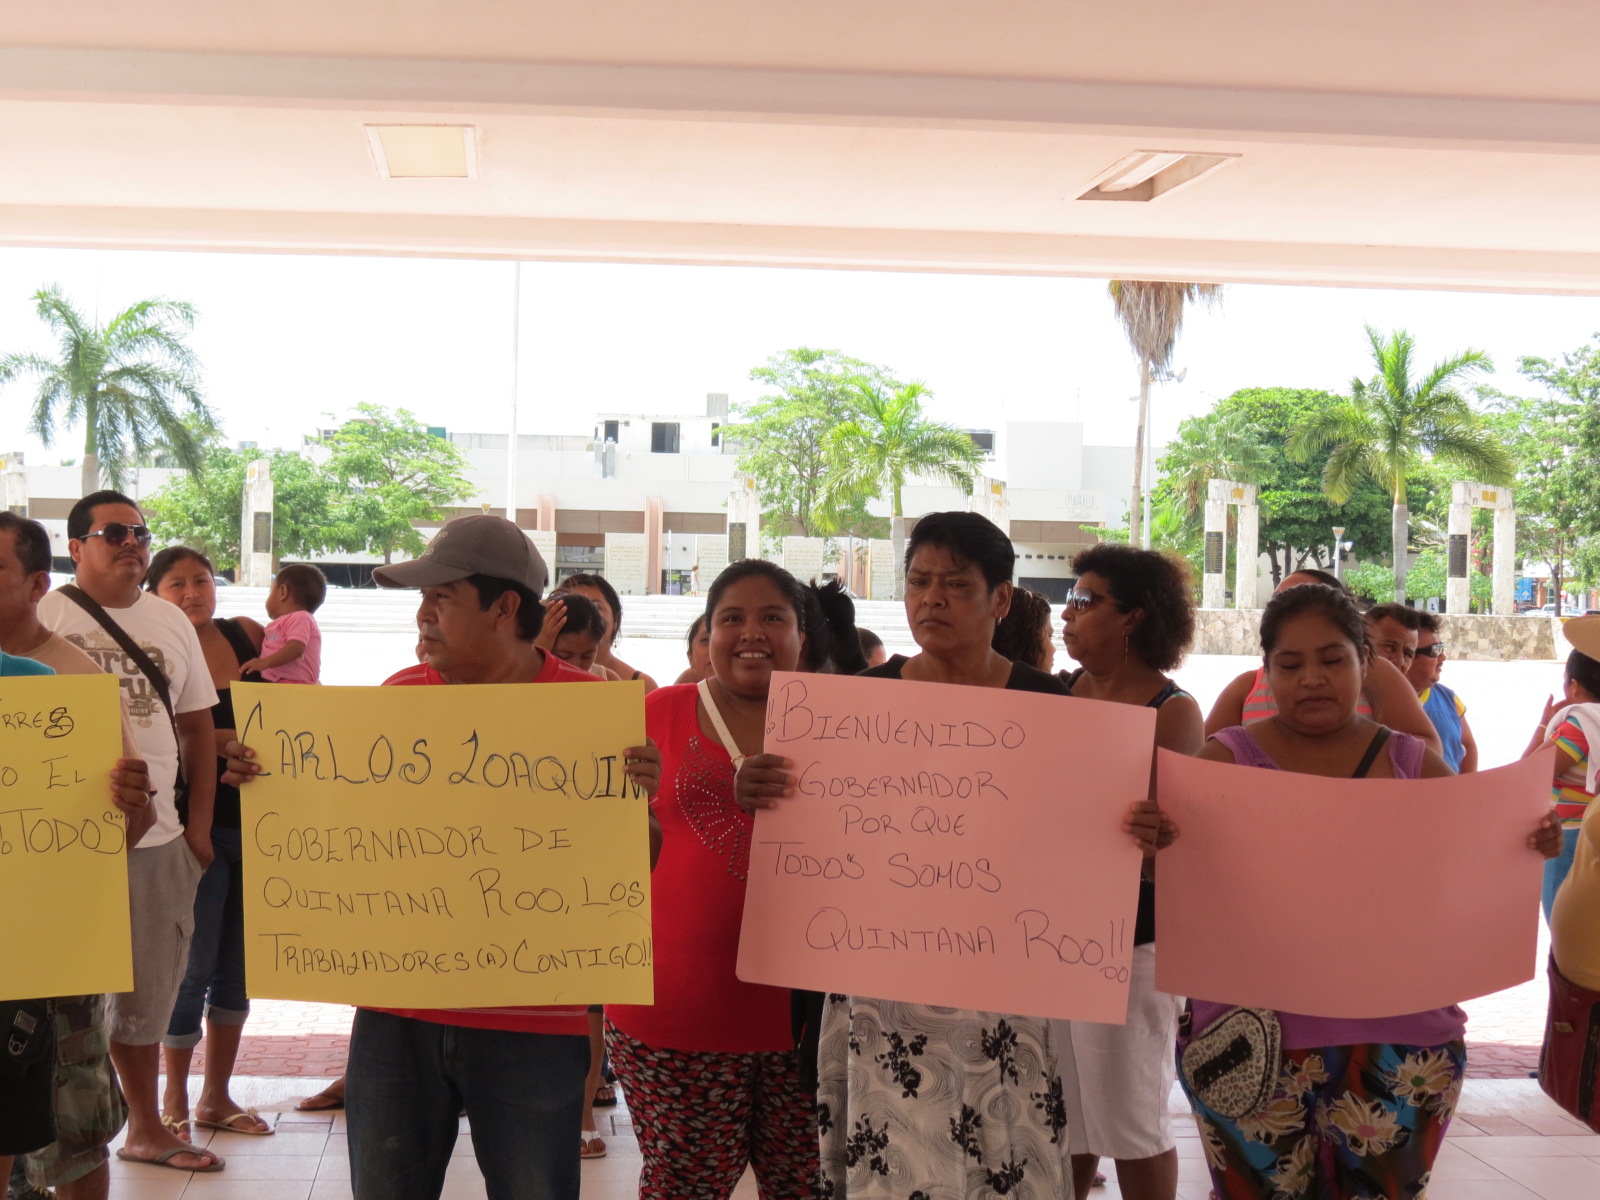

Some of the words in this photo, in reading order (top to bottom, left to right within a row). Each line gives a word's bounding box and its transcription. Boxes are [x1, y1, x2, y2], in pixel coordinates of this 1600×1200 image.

[241, 700, 432, 785] CARLOS
[42, 755, 86, 790] EL
[799, 761, 1009, 801] GOBERNADOR
[255, 812, 498, 863] GOBERNADOR
[514, 827, 572, 852] DE
[839, 804, 901, 835] POR
[911, 806, 966, 836] QUE
[759, 842, 864, 879] TODOS
[888, 853, 1001, 893] SOMOS
[264, 877, 454, 918] QUINTANA
[582, 877, 645, 907] LOS
[806, 907, 995, 955] QUINTANA
